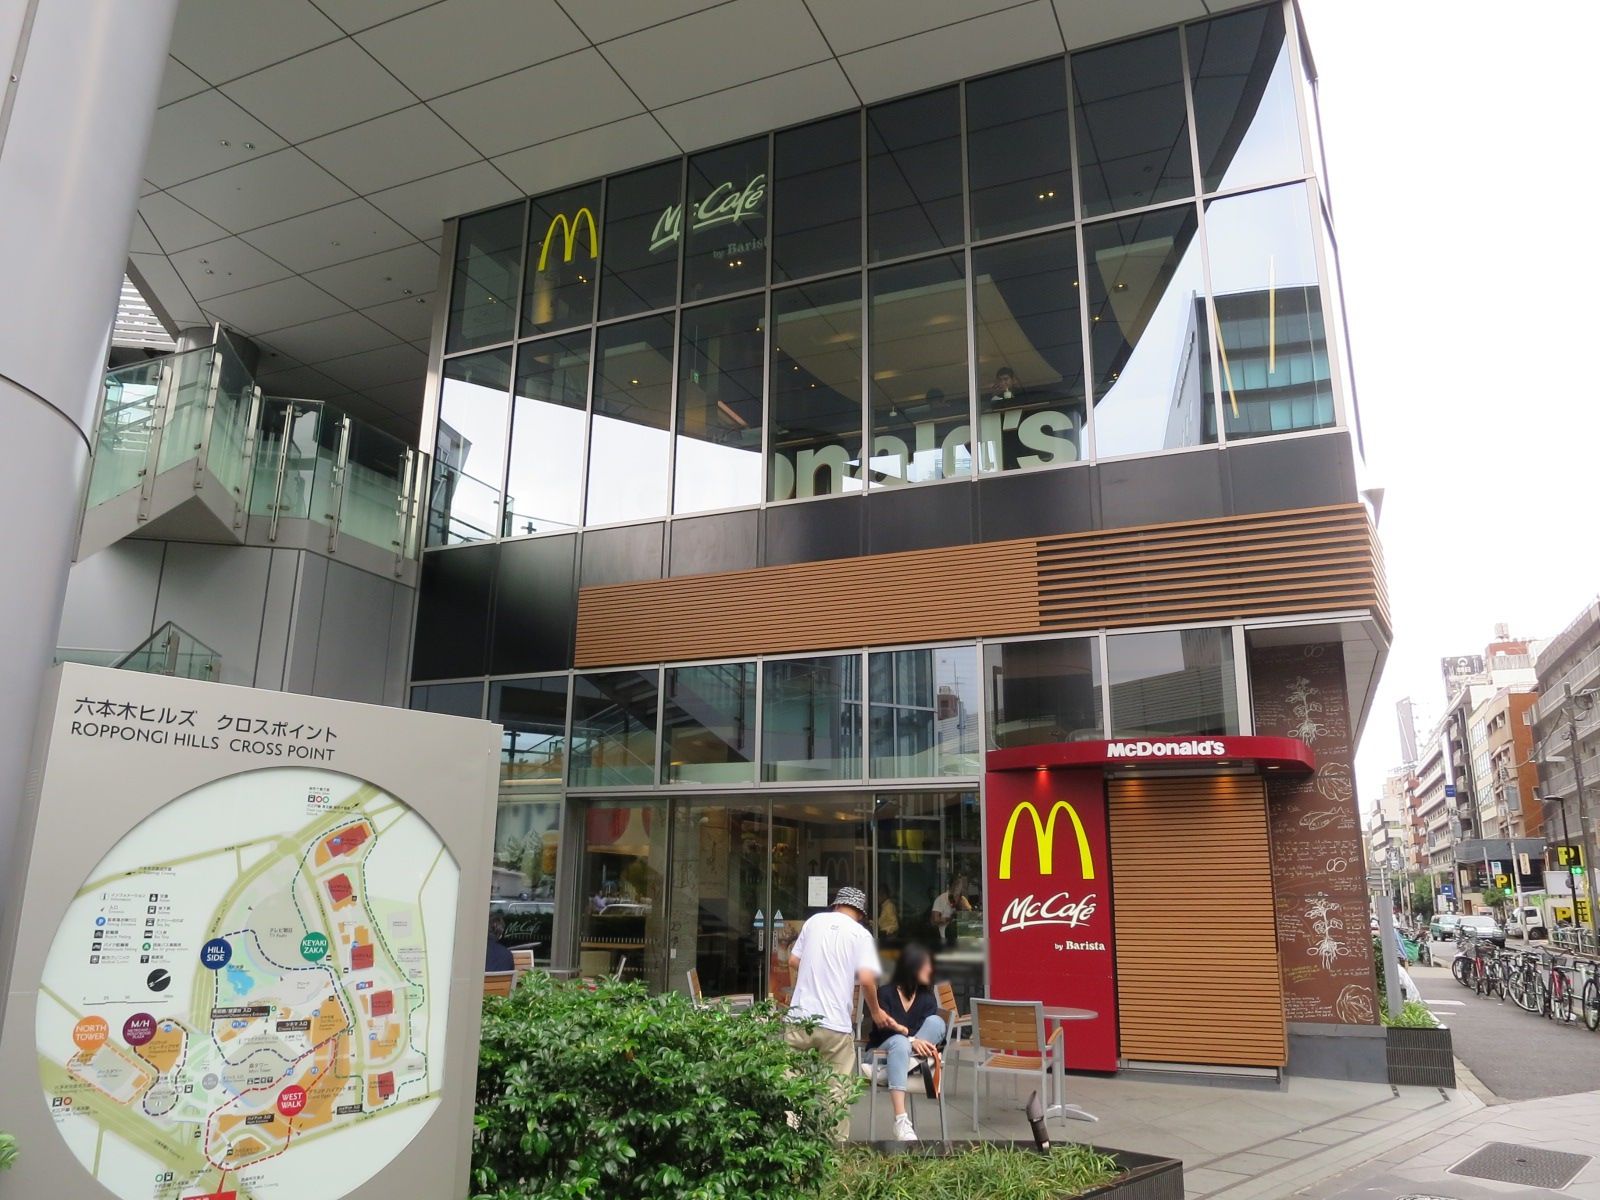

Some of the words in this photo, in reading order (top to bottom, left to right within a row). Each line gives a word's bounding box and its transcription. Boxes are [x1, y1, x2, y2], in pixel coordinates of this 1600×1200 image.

[74, 697, 198, 727] 六本木ヒルズ
[217, 714, 337, 743] クロスポイント
[71, 721, 168, 744] ROPPONGI
[174, 732, 219, 750] HILLS
[229, 738, 282, 756] CROSS
[288, 745, 335, 761] POINT
[1107, 741, 1225, 757] McDonald's
[1496, 874, 1508, 888] P
[1000, 892, 1096, 932] McCafé
[303, 939, 327, 947] KEYAKI
[1055, 943, 1063, 951] by
[1066, 940, 1106, 951] Barista
[207, 946, 225, 954] HILL
[304, 946, 324, 954] ZAKA
[206, 954, 225, 962] SIDE
[75, 1024, 107, 1033] NORTH
[131, 1020, 150, 1028] M/H
[75, 1032, 106, 1041] TOWER
[281, 1093, 303, 1101] WEST
[281, 1100, 302, 1109] WALK
